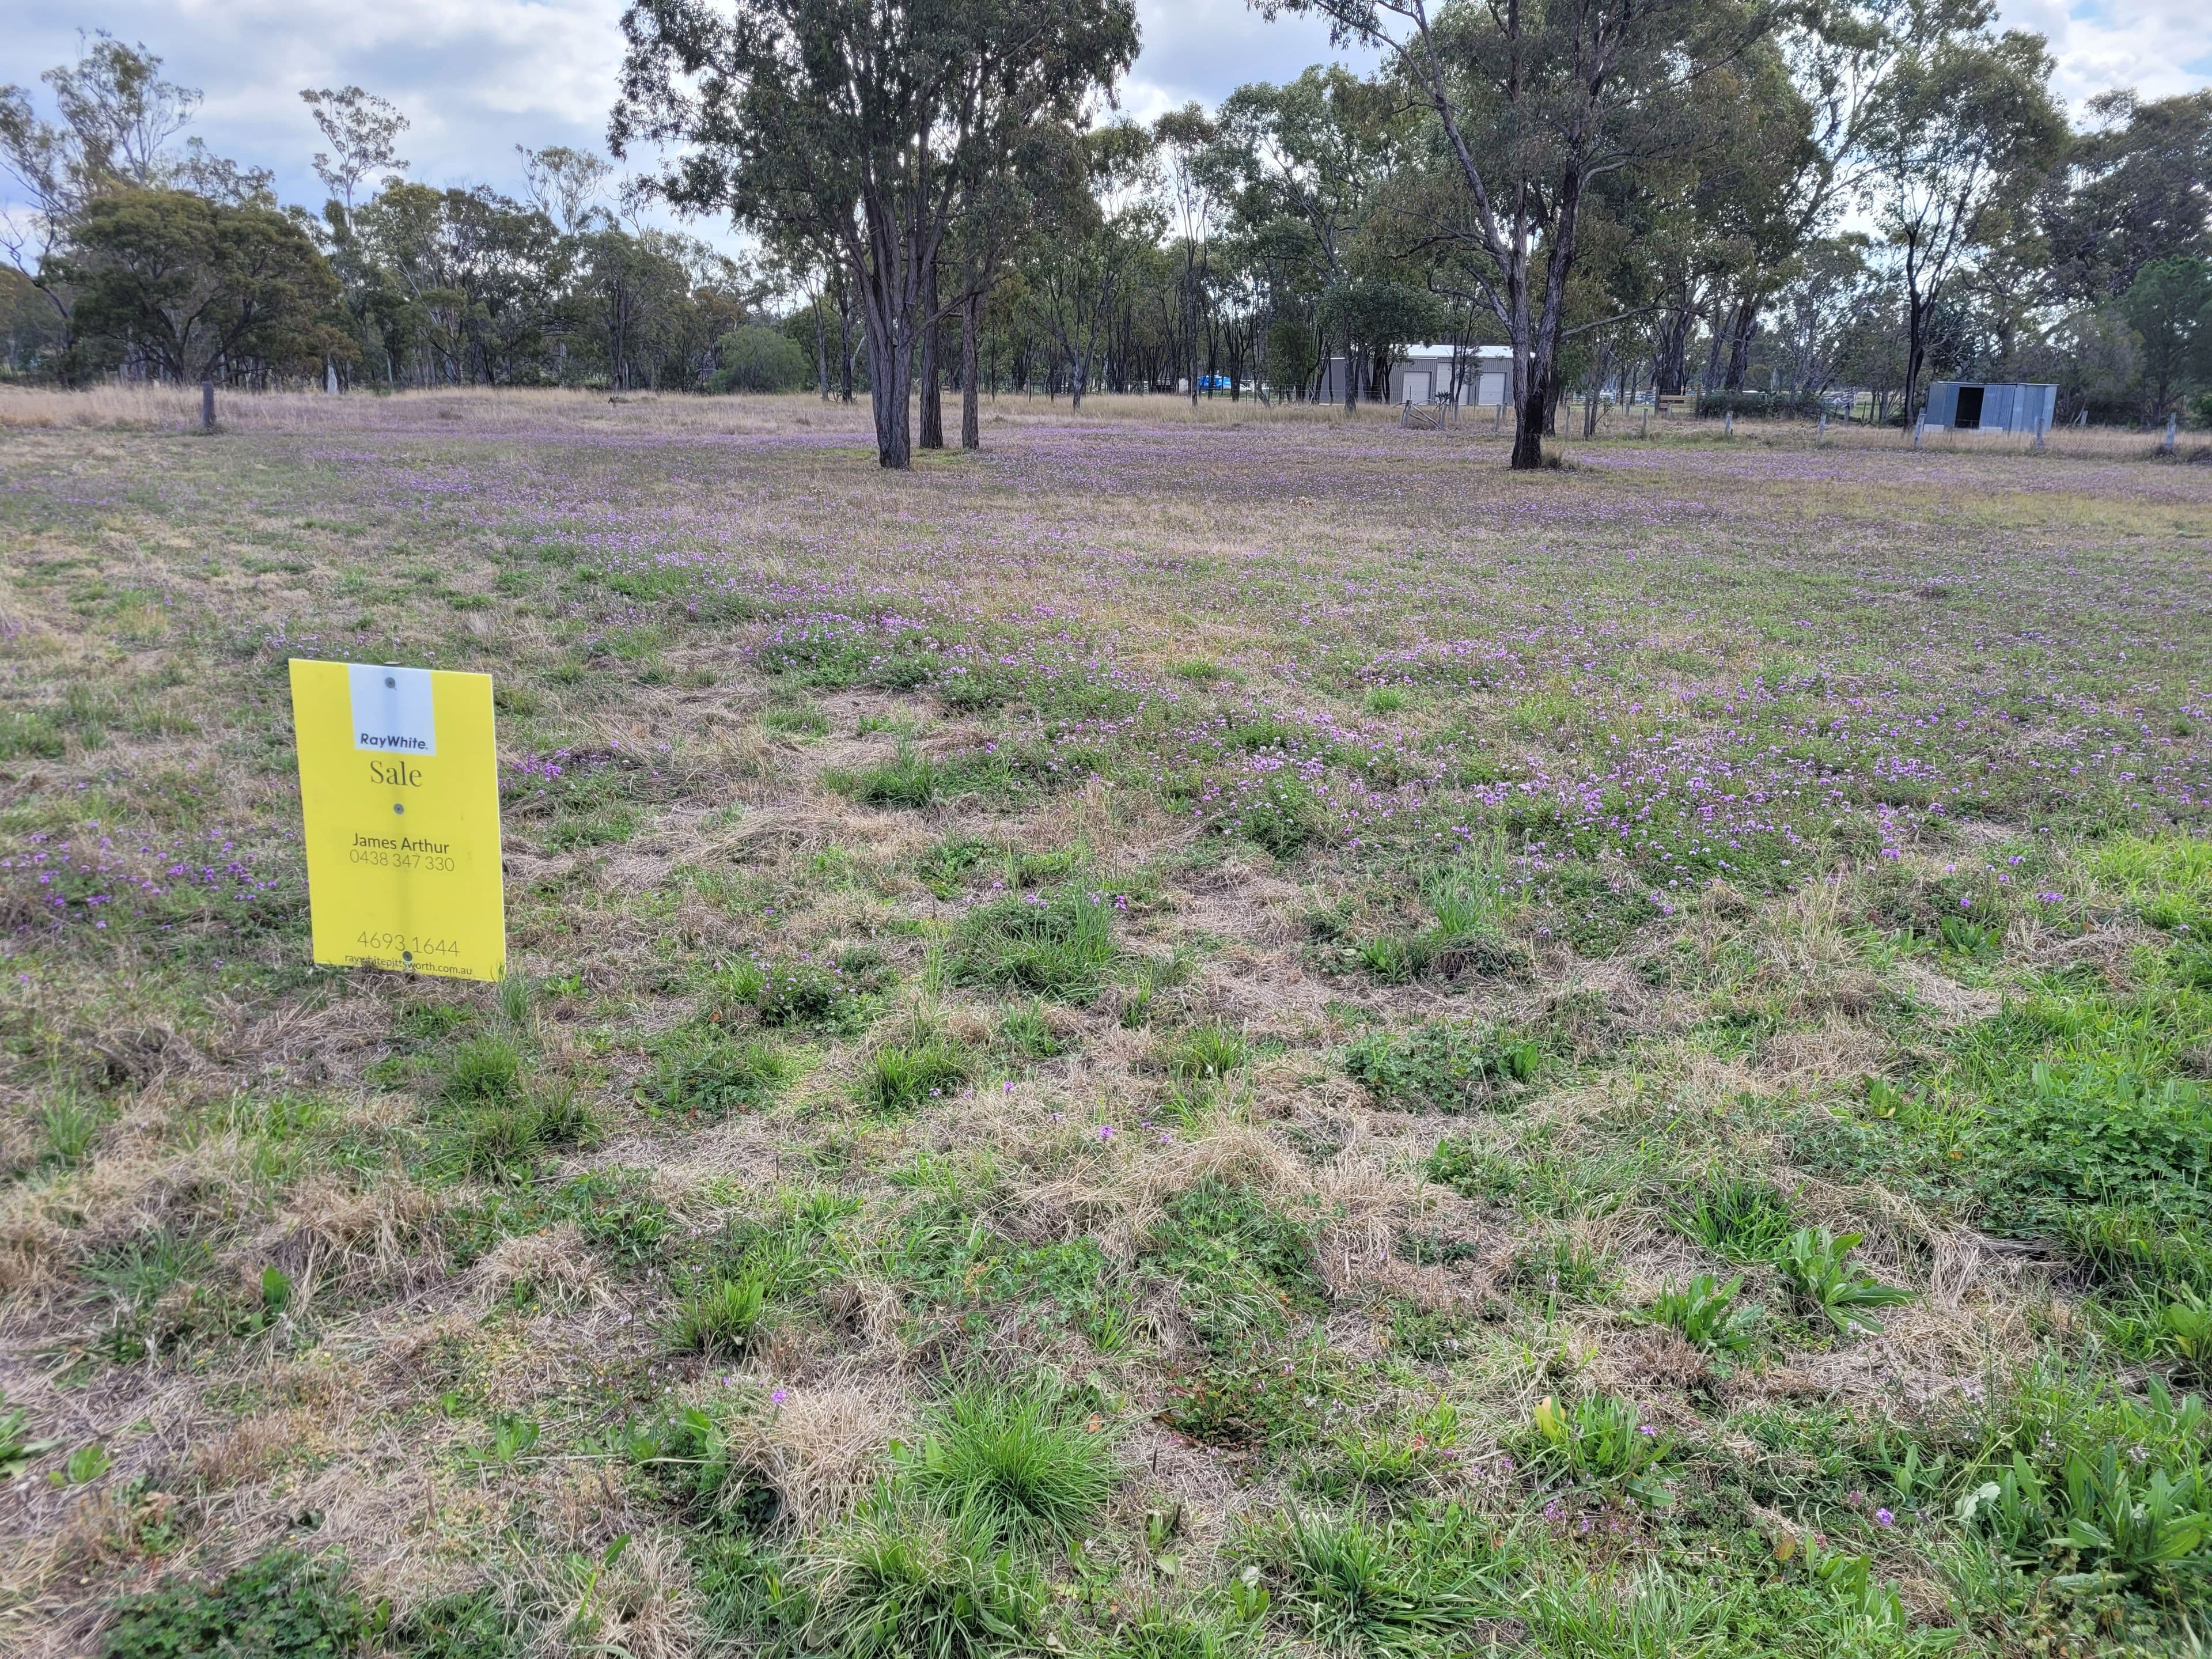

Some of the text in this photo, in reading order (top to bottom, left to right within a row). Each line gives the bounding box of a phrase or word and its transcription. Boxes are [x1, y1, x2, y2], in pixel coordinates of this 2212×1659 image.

[370, 760, 423, 787] Sale
[353, 832, 450, 854] James Arthur
[350, 849, 454, 872] 0438 347 330
[357, 931, 460, 957] 4693 1644
